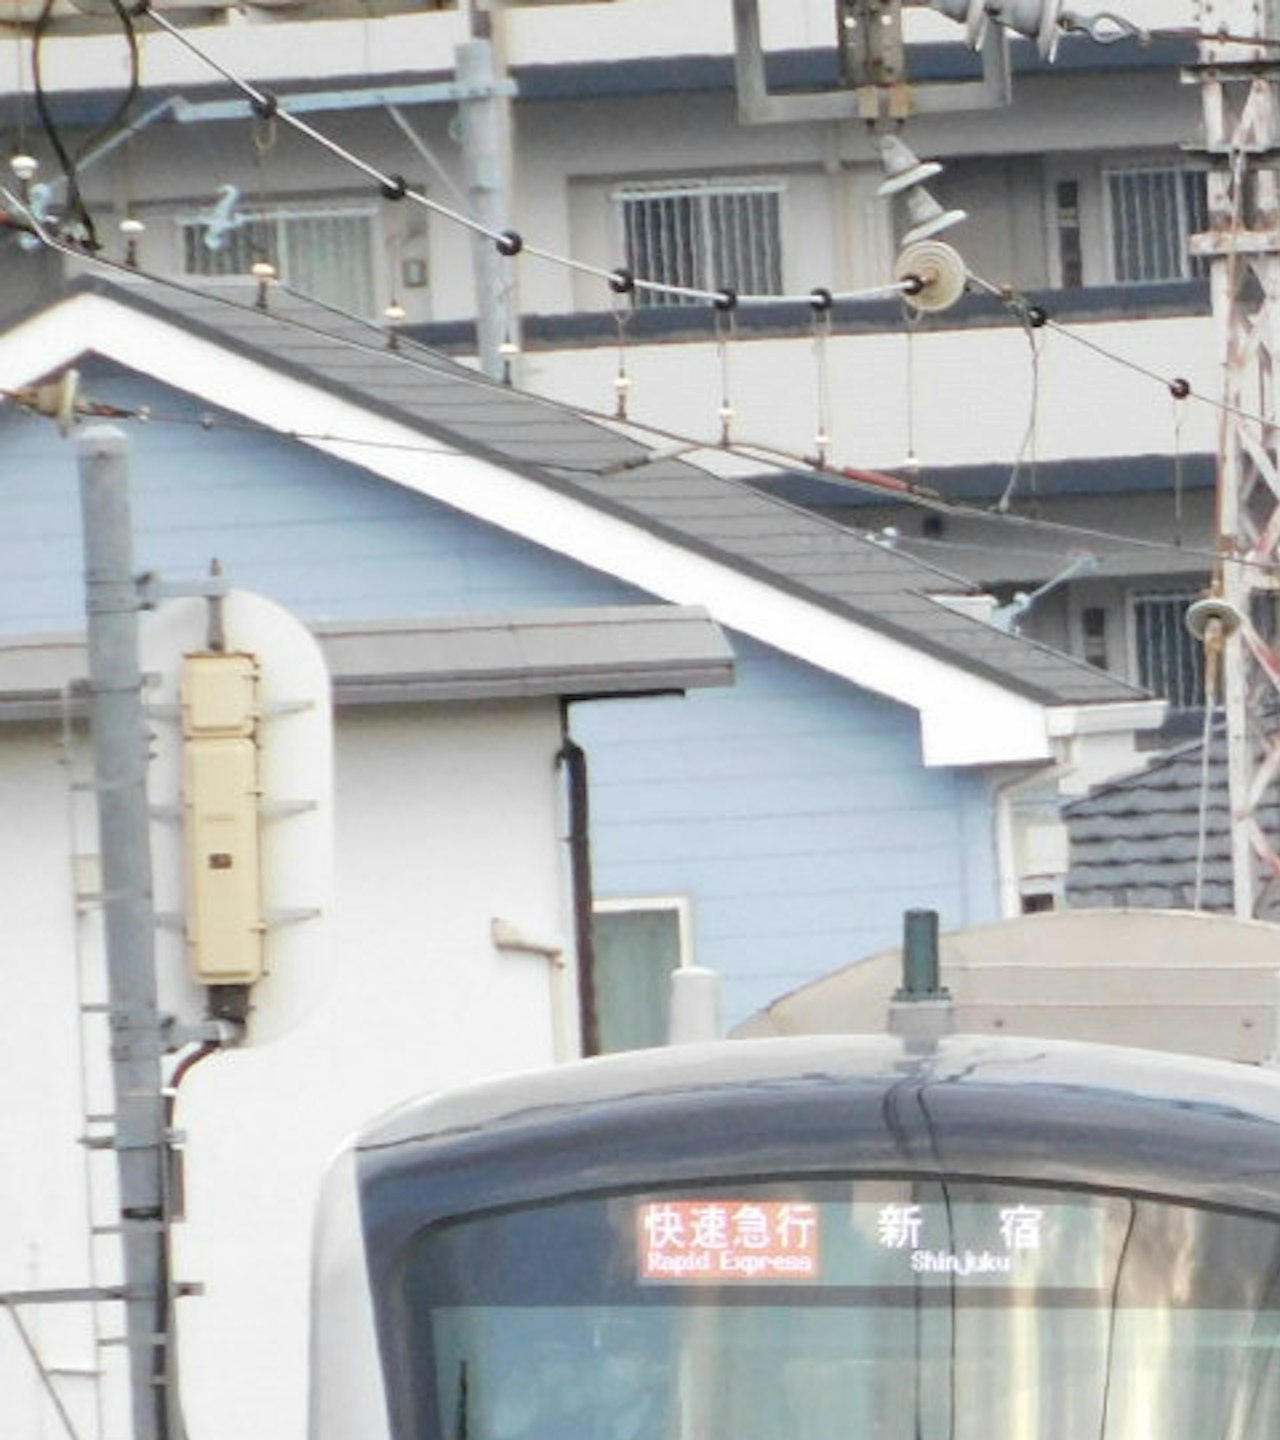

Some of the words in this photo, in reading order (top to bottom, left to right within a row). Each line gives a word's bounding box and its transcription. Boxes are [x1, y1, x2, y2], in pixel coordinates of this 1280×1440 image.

[644, 1203, 816, 1249] 快速急行
[647, 1253, 710, 1276] Rapid
[719, 1253, 812, 1276] Express
[911, 1250, 1011, 1276] Shinjuku
